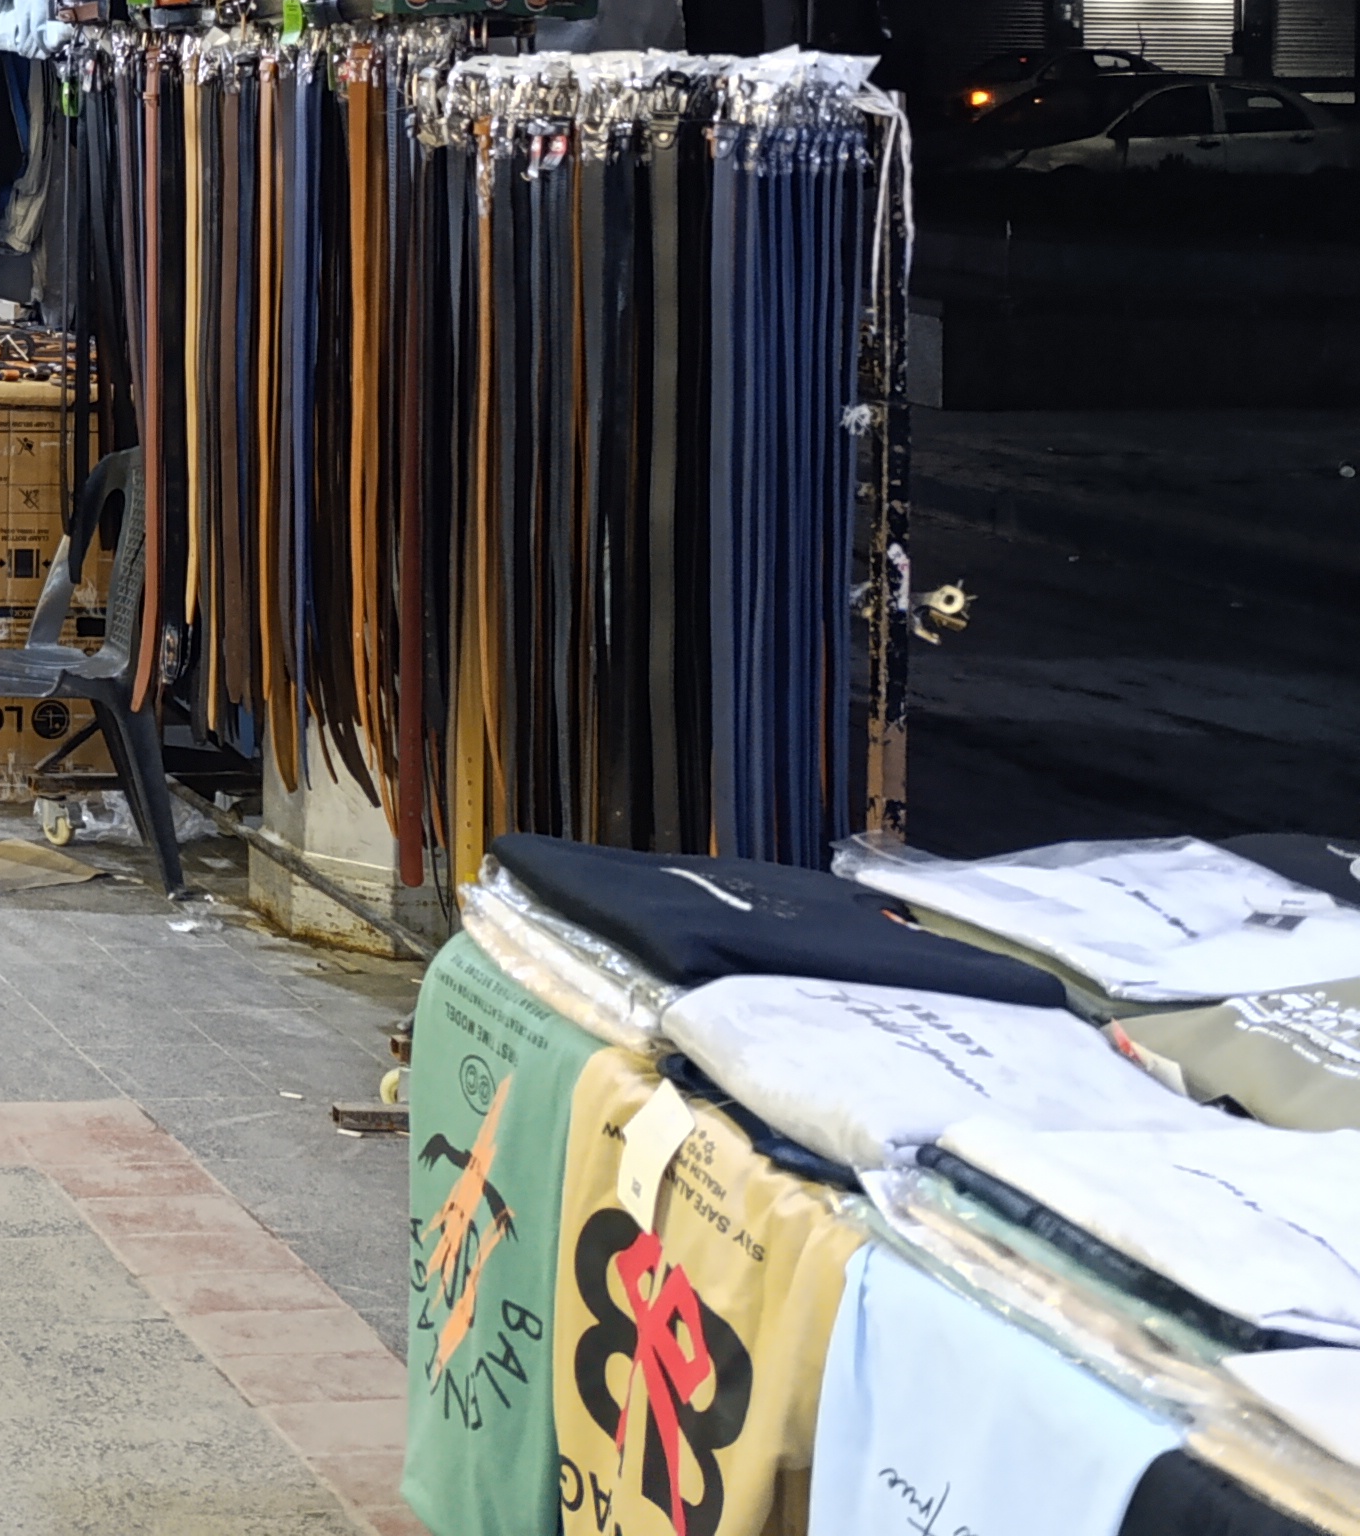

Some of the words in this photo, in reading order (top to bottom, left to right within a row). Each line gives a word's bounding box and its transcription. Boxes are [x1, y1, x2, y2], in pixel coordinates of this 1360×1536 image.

[444, 1001, 476, 1035] MODEL
[689, 1163, 727, 1202] HEALTH
[693, 1197, 731, 1234] SAFE
